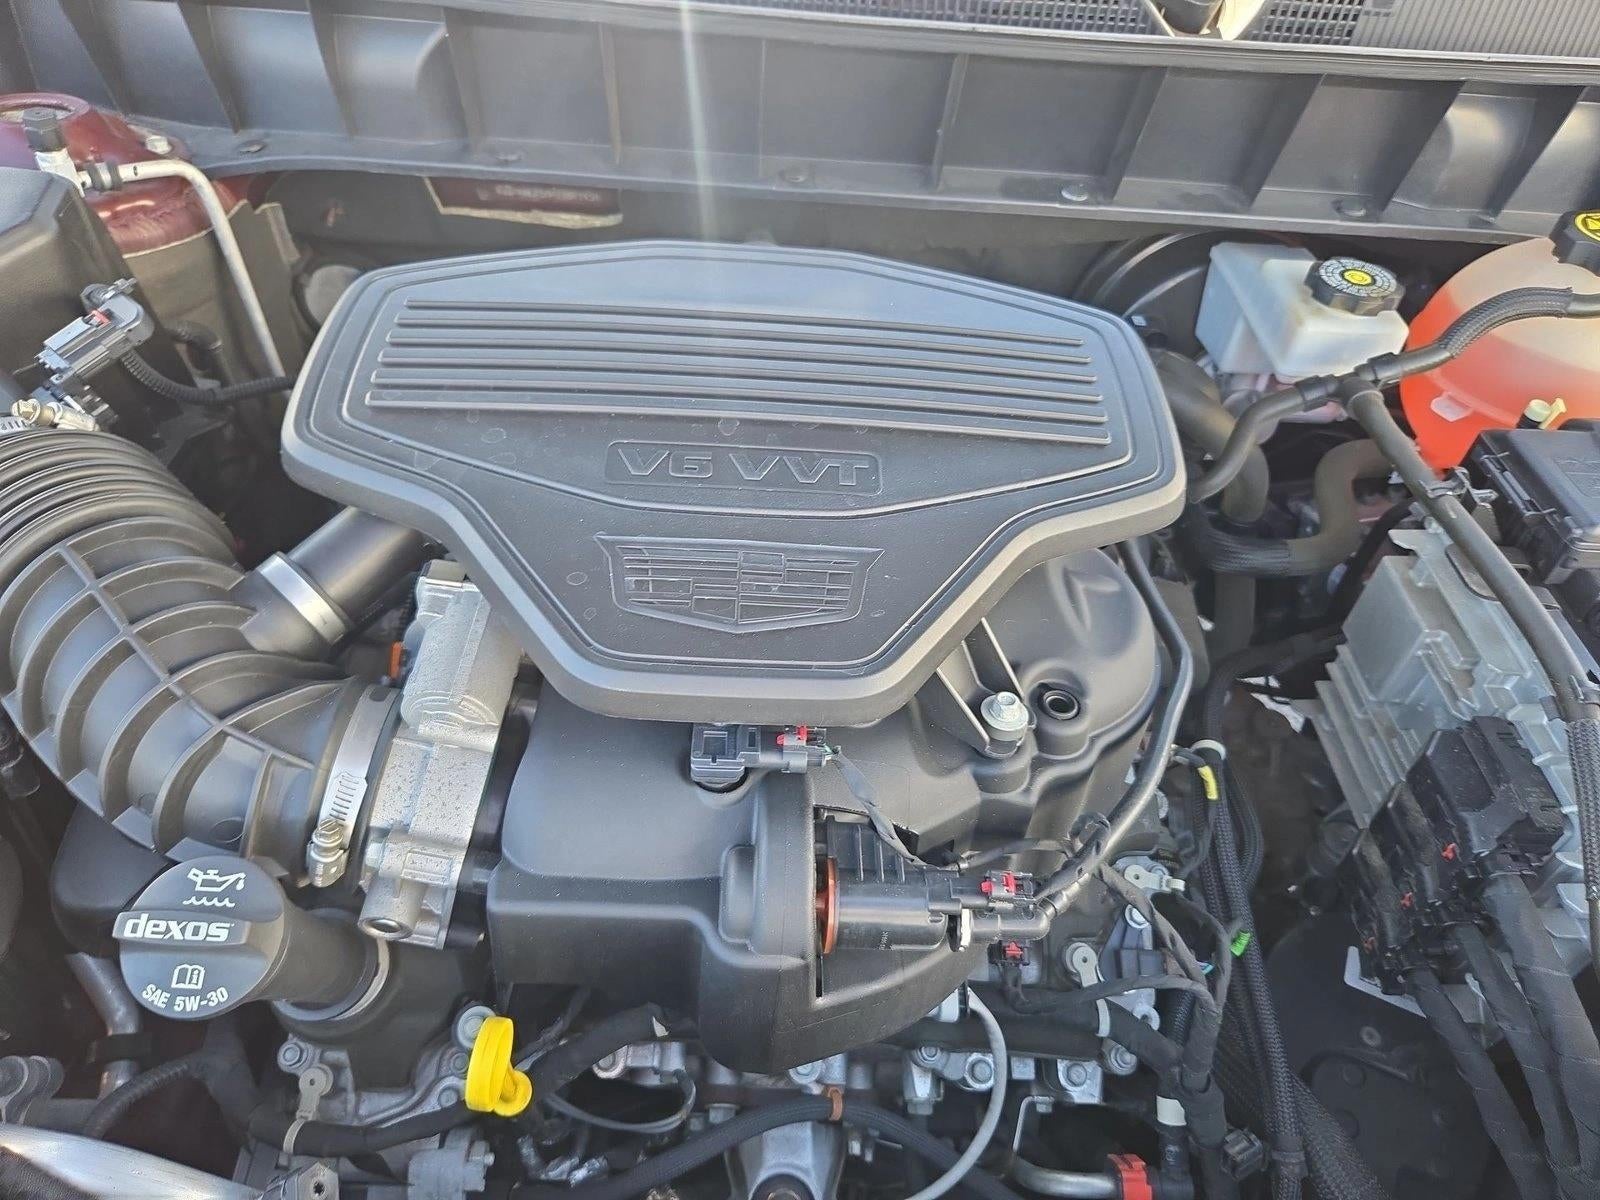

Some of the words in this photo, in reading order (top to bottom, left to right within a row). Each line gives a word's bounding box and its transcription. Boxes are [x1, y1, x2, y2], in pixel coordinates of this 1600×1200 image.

[617, 448, 713, 478] V6
[728, 453, 870, 486] VVT
[123, 913, 231, 942] dexos
[141, 983, 171, 1009] SAE
[173, 986, 229, 1012] 5W-30
